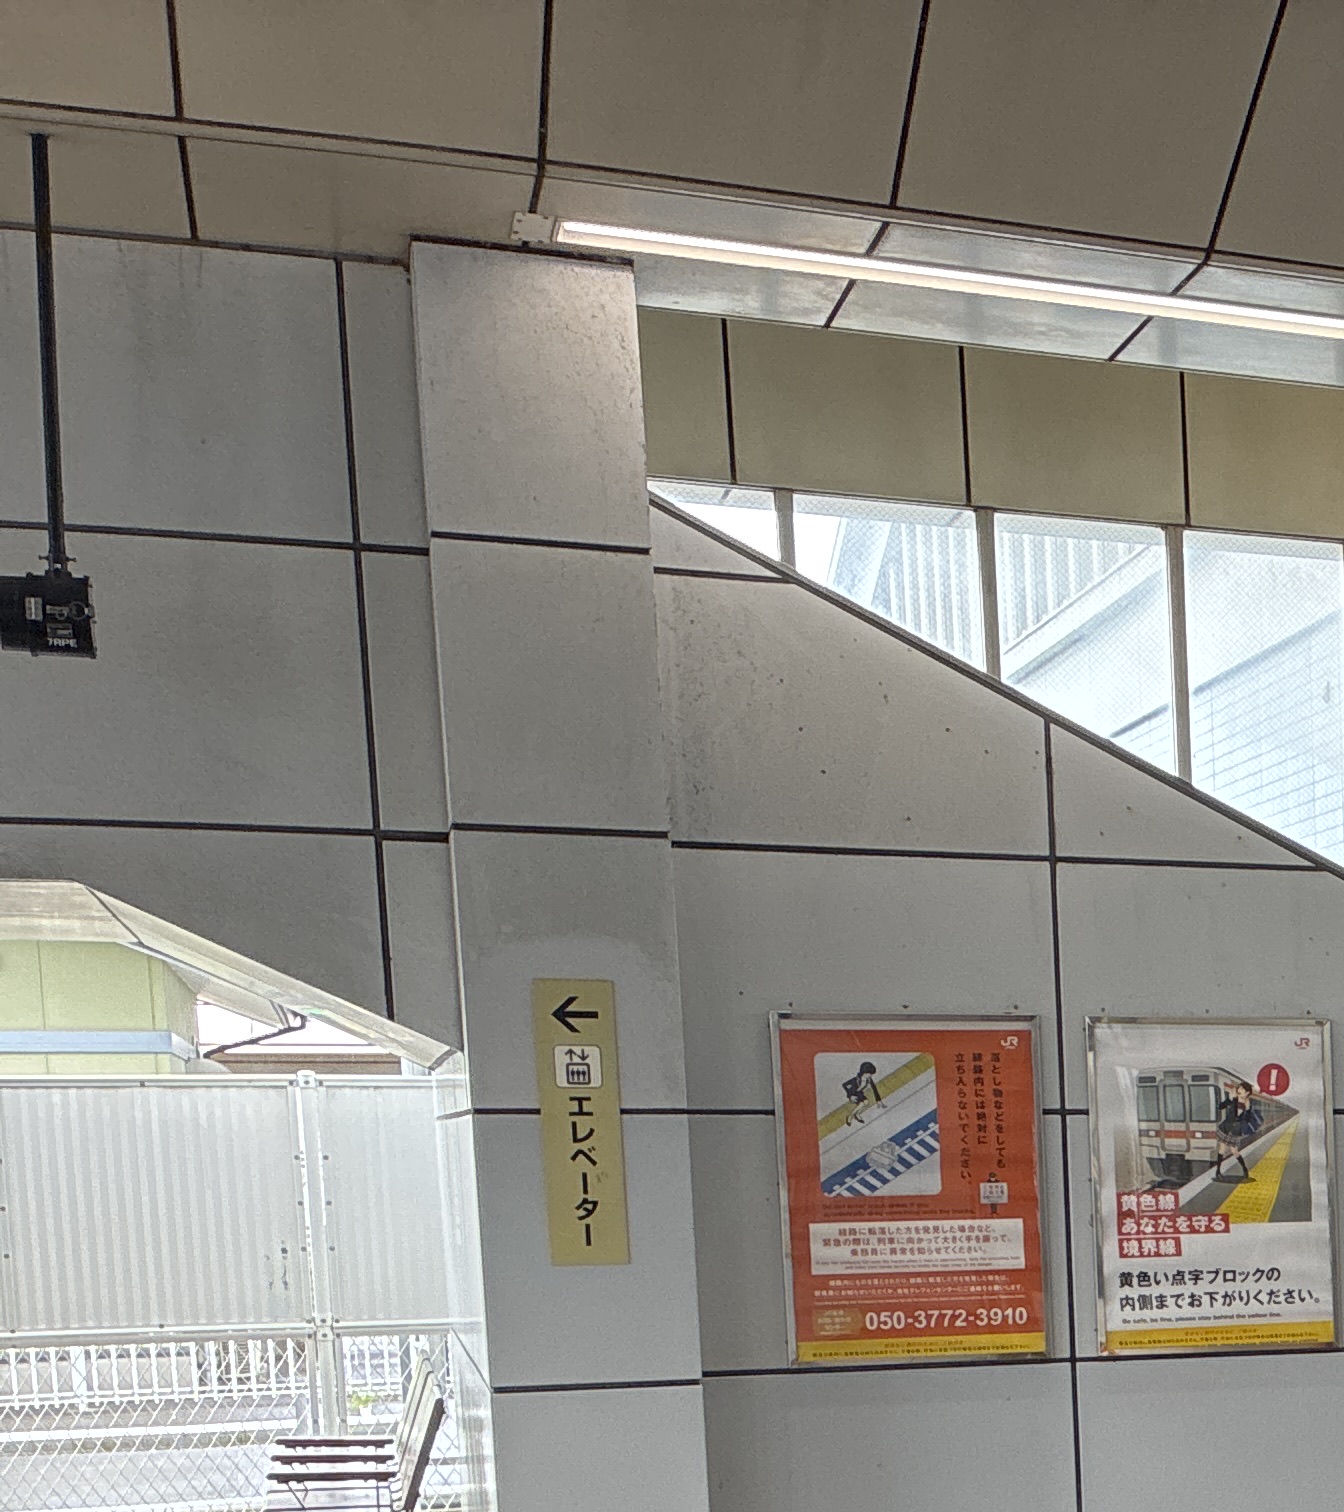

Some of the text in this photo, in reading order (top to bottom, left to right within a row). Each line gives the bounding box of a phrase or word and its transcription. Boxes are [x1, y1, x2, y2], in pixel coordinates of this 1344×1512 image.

[1001, 1036, 1019, 1047] JR
[1294, 1037, 1310, 1048] JR
[568, 1096, 599, 1247] エレベーター
[1120, 1193, 1176, 1212] 黄色線
[1121, 1215, 1226, 1234] あなたを守る
[1122, 1238, 1177, 1257] 境界線
[1118, 1267, 1281, 1289] 黄色い点字ブロックの
[1119, 1288, 1320, 1312] 内側までお下がりください。
[865, 1306, 1028, 1331] 050-3772-3910
